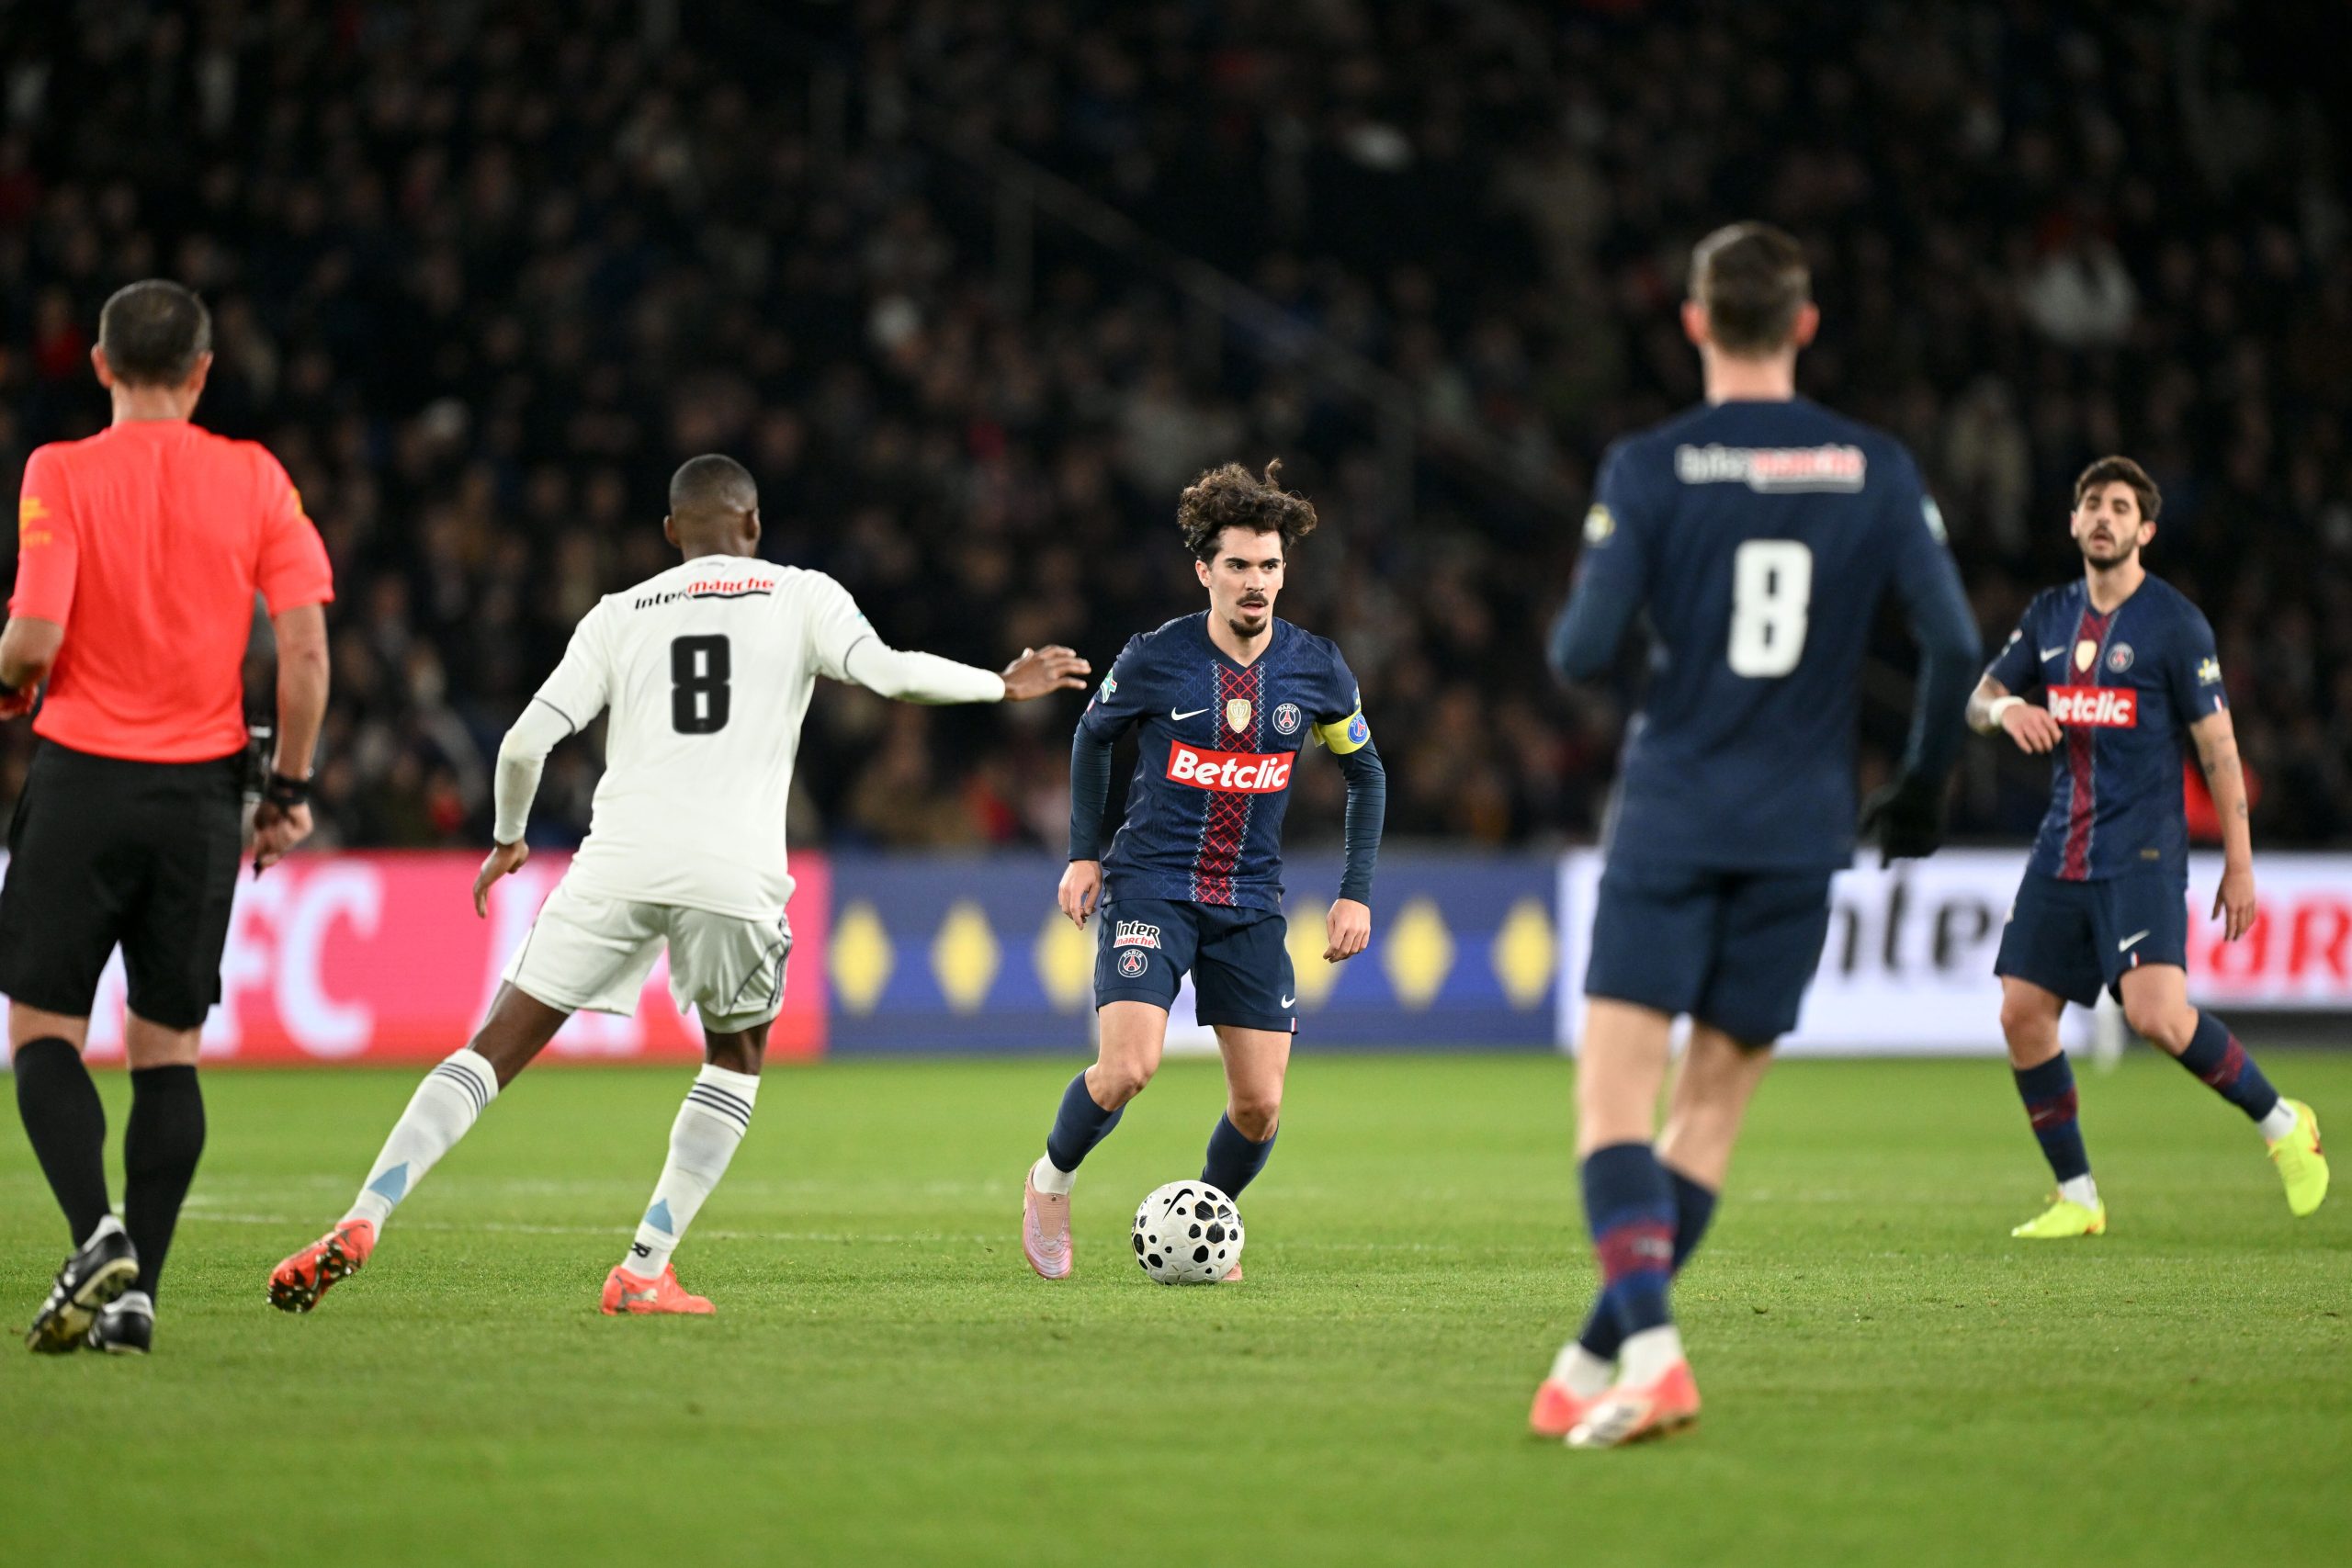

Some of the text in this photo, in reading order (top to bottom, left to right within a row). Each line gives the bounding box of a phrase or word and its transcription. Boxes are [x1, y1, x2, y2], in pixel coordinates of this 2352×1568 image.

[1728, 538, 1813, 678] 8
[672, 634, 731, 735] 8
[1278, 705, 1296, 713] PARIS
[1171, 749, 1289, 789] Betclic
[1122, 950, 1143, 958] PARIS
